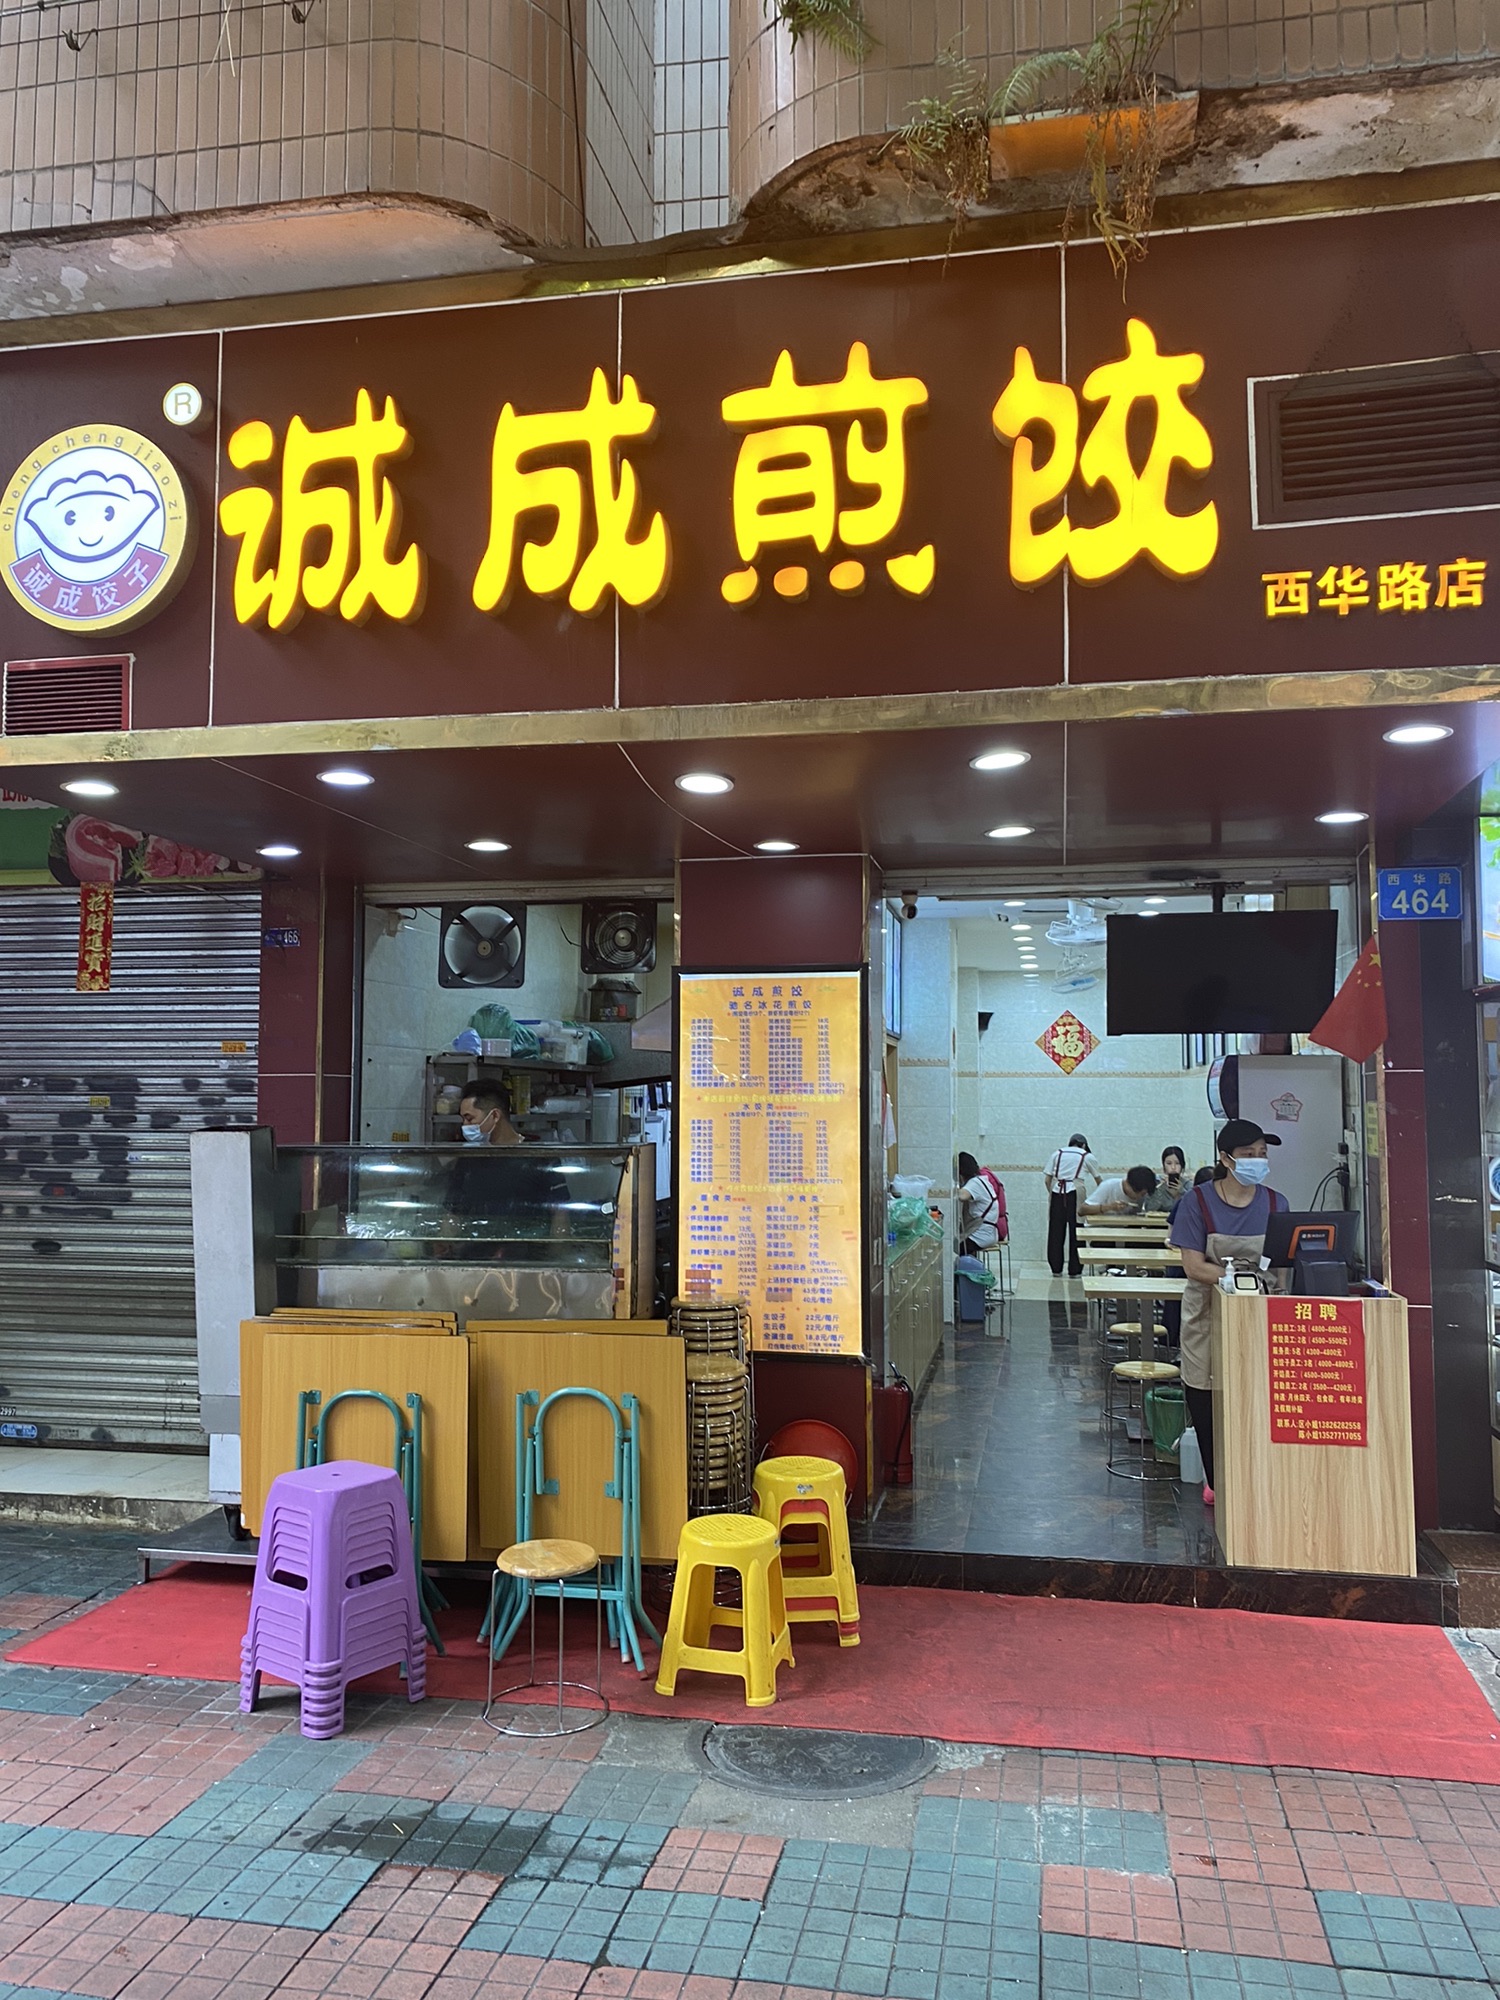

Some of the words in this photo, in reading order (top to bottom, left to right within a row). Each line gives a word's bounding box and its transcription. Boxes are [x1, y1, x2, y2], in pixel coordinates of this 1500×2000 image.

[174, 392, 192, 415] R
[2, 458, 43, 532] cheng
[52, 432, 124, 454] cheng
[133, 443, 171, 487] jiao
[168, 499, 182, 521] zi
[219, 317, 1220, 631] 诚成煎饺
[22, 558, 150, 614] 诚成饺子
[1261, 557, 1487, 617] 西华路店
[1387, 872, 1452, 886] 西华路
[1391, 889, 1449, 915] 464
[1051, 1024, 1085, 1058] 福
[1294, 1303, 1337, 1320] 招聘
